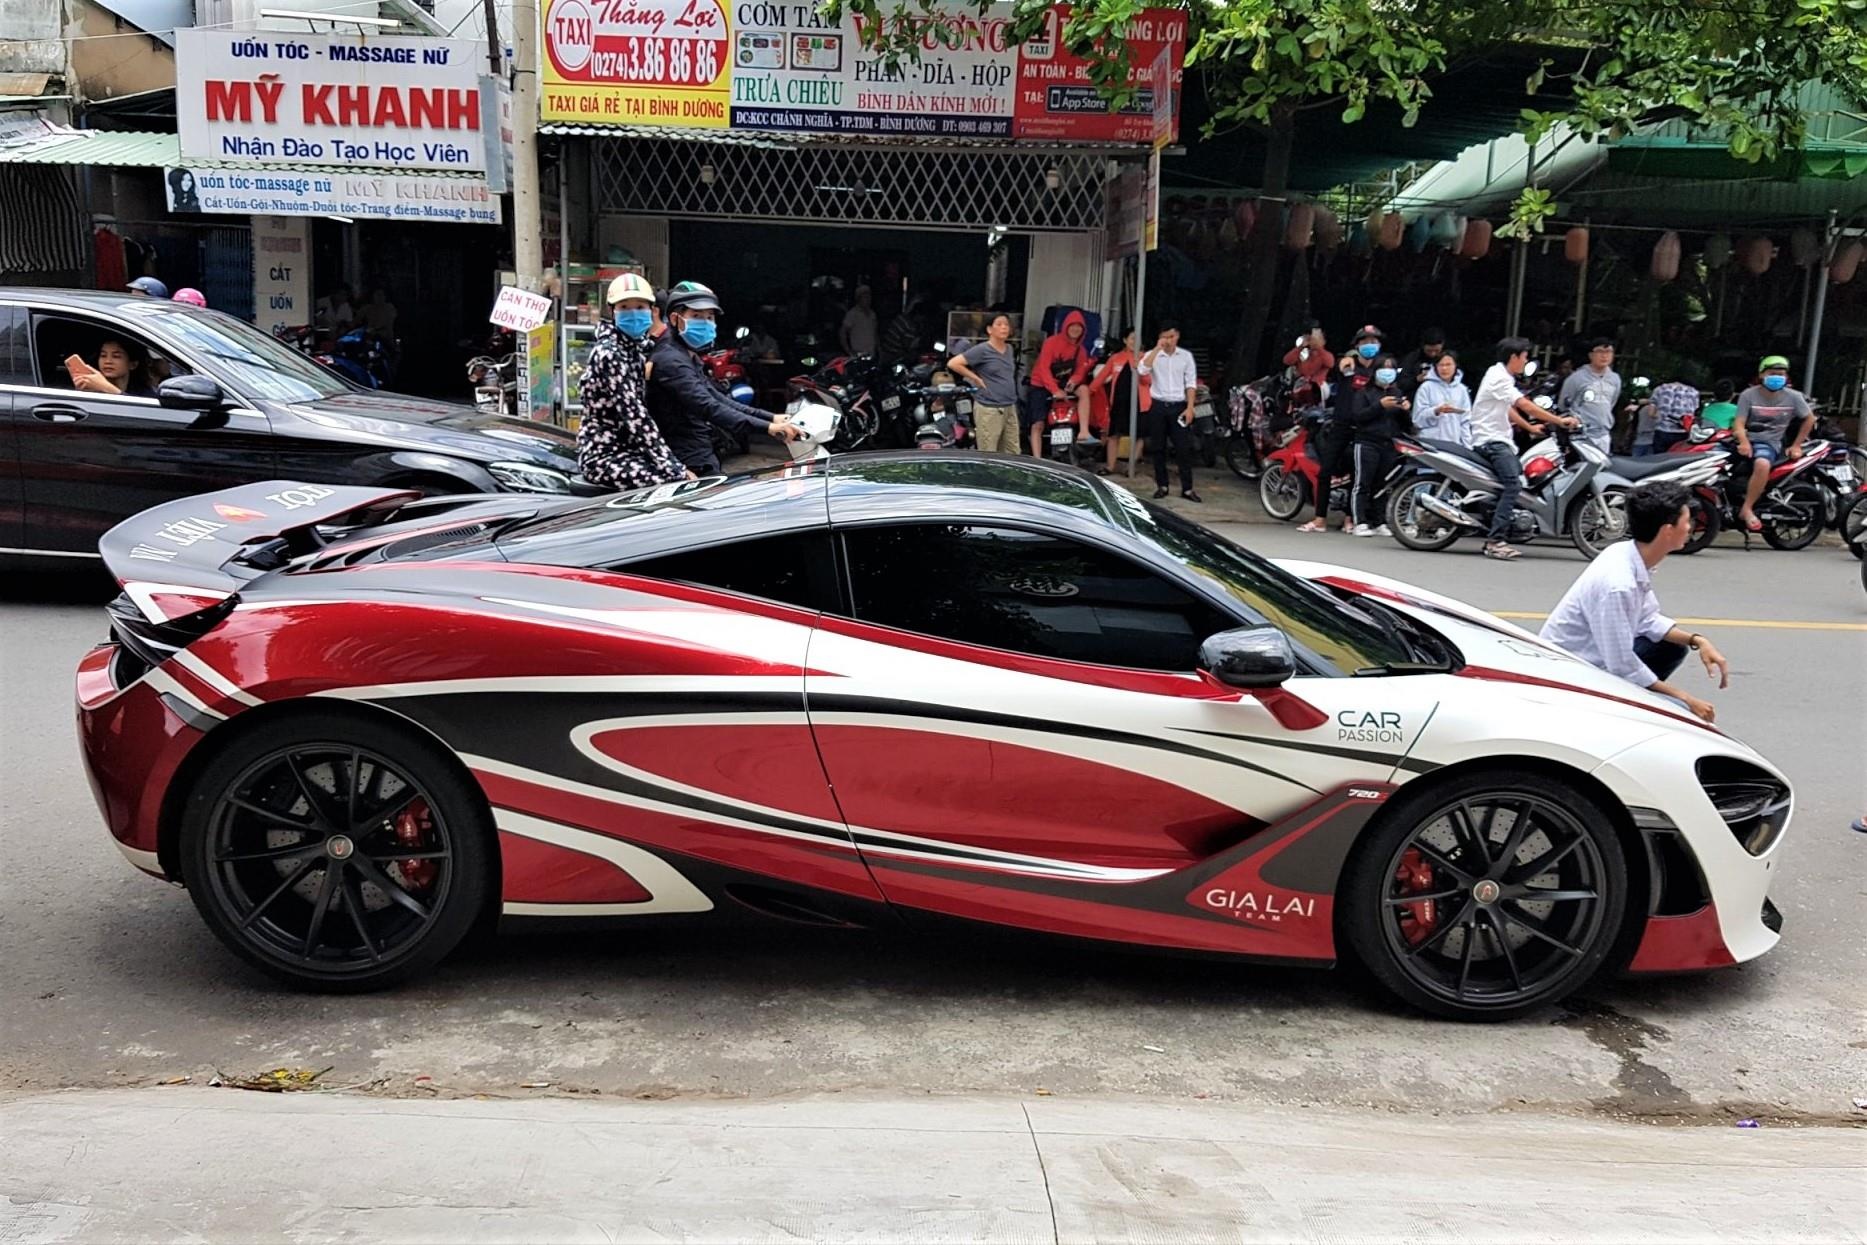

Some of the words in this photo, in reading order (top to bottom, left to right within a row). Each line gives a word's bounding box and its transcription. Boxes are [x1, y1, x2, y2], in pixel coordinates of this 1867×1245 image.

[673, 0, 717, 34] Lợi
[738, 1, 787, 27] CƠM
[555, 17, 591, 46] TAXI
[231, 36, 269, 58] UỐN
[276, 39, 310, 59] TÓC
[329, 45, 417, 64] MASSAGE
[423, 46, 450, 65] NỮ
[669, 38, 691, 83] 86
[695, 39, 717, 83] 86
[1029, 45, 1049, 56] TAXI
[971, 59, 1011, 92] HỘP
[1023, 64, 1038, 78] AN
[1039, 61, 1067, 78] TOÀN
[204, 73, 285, 124] MỸ
[302, 83, 480, 131] KHANH
[734, 73, 781, 103] TRƯA
[857, 88, 892, 110] BÌNH
[930, 91, 966, 113] KÍNH
[548, 95, 576, 113] TAXI
[580, 91, 600, 113] GIÁ
[604, 91, 620, 114] RẺ
[625, 98, 645, 118] TẠI
[650, 95, 678, 116] BÌNH
[683, 98, 724, 119] DƯƠNG
[770, 110, 803, 126] CHÁNH
[880, 114, 901, 130] BÌNH
[222, 136, 276, 160] Nhận
[282, 138, 324, 158] Đào
[331, 140, 370, 164] Tạo
[375, 141, 416, 166] Học
[423, 143, 470, 163] Viên
[395, 181, 489, 203] KHANH
[1337, 710, 1401, 729] CAR
[1338, 728, 1403, 744] PASSION
[1206, 888, 1258, 911] GIA
[1265, 894, 1315, 917] LAI
[1233, 910, 1282, 922] TEAM
